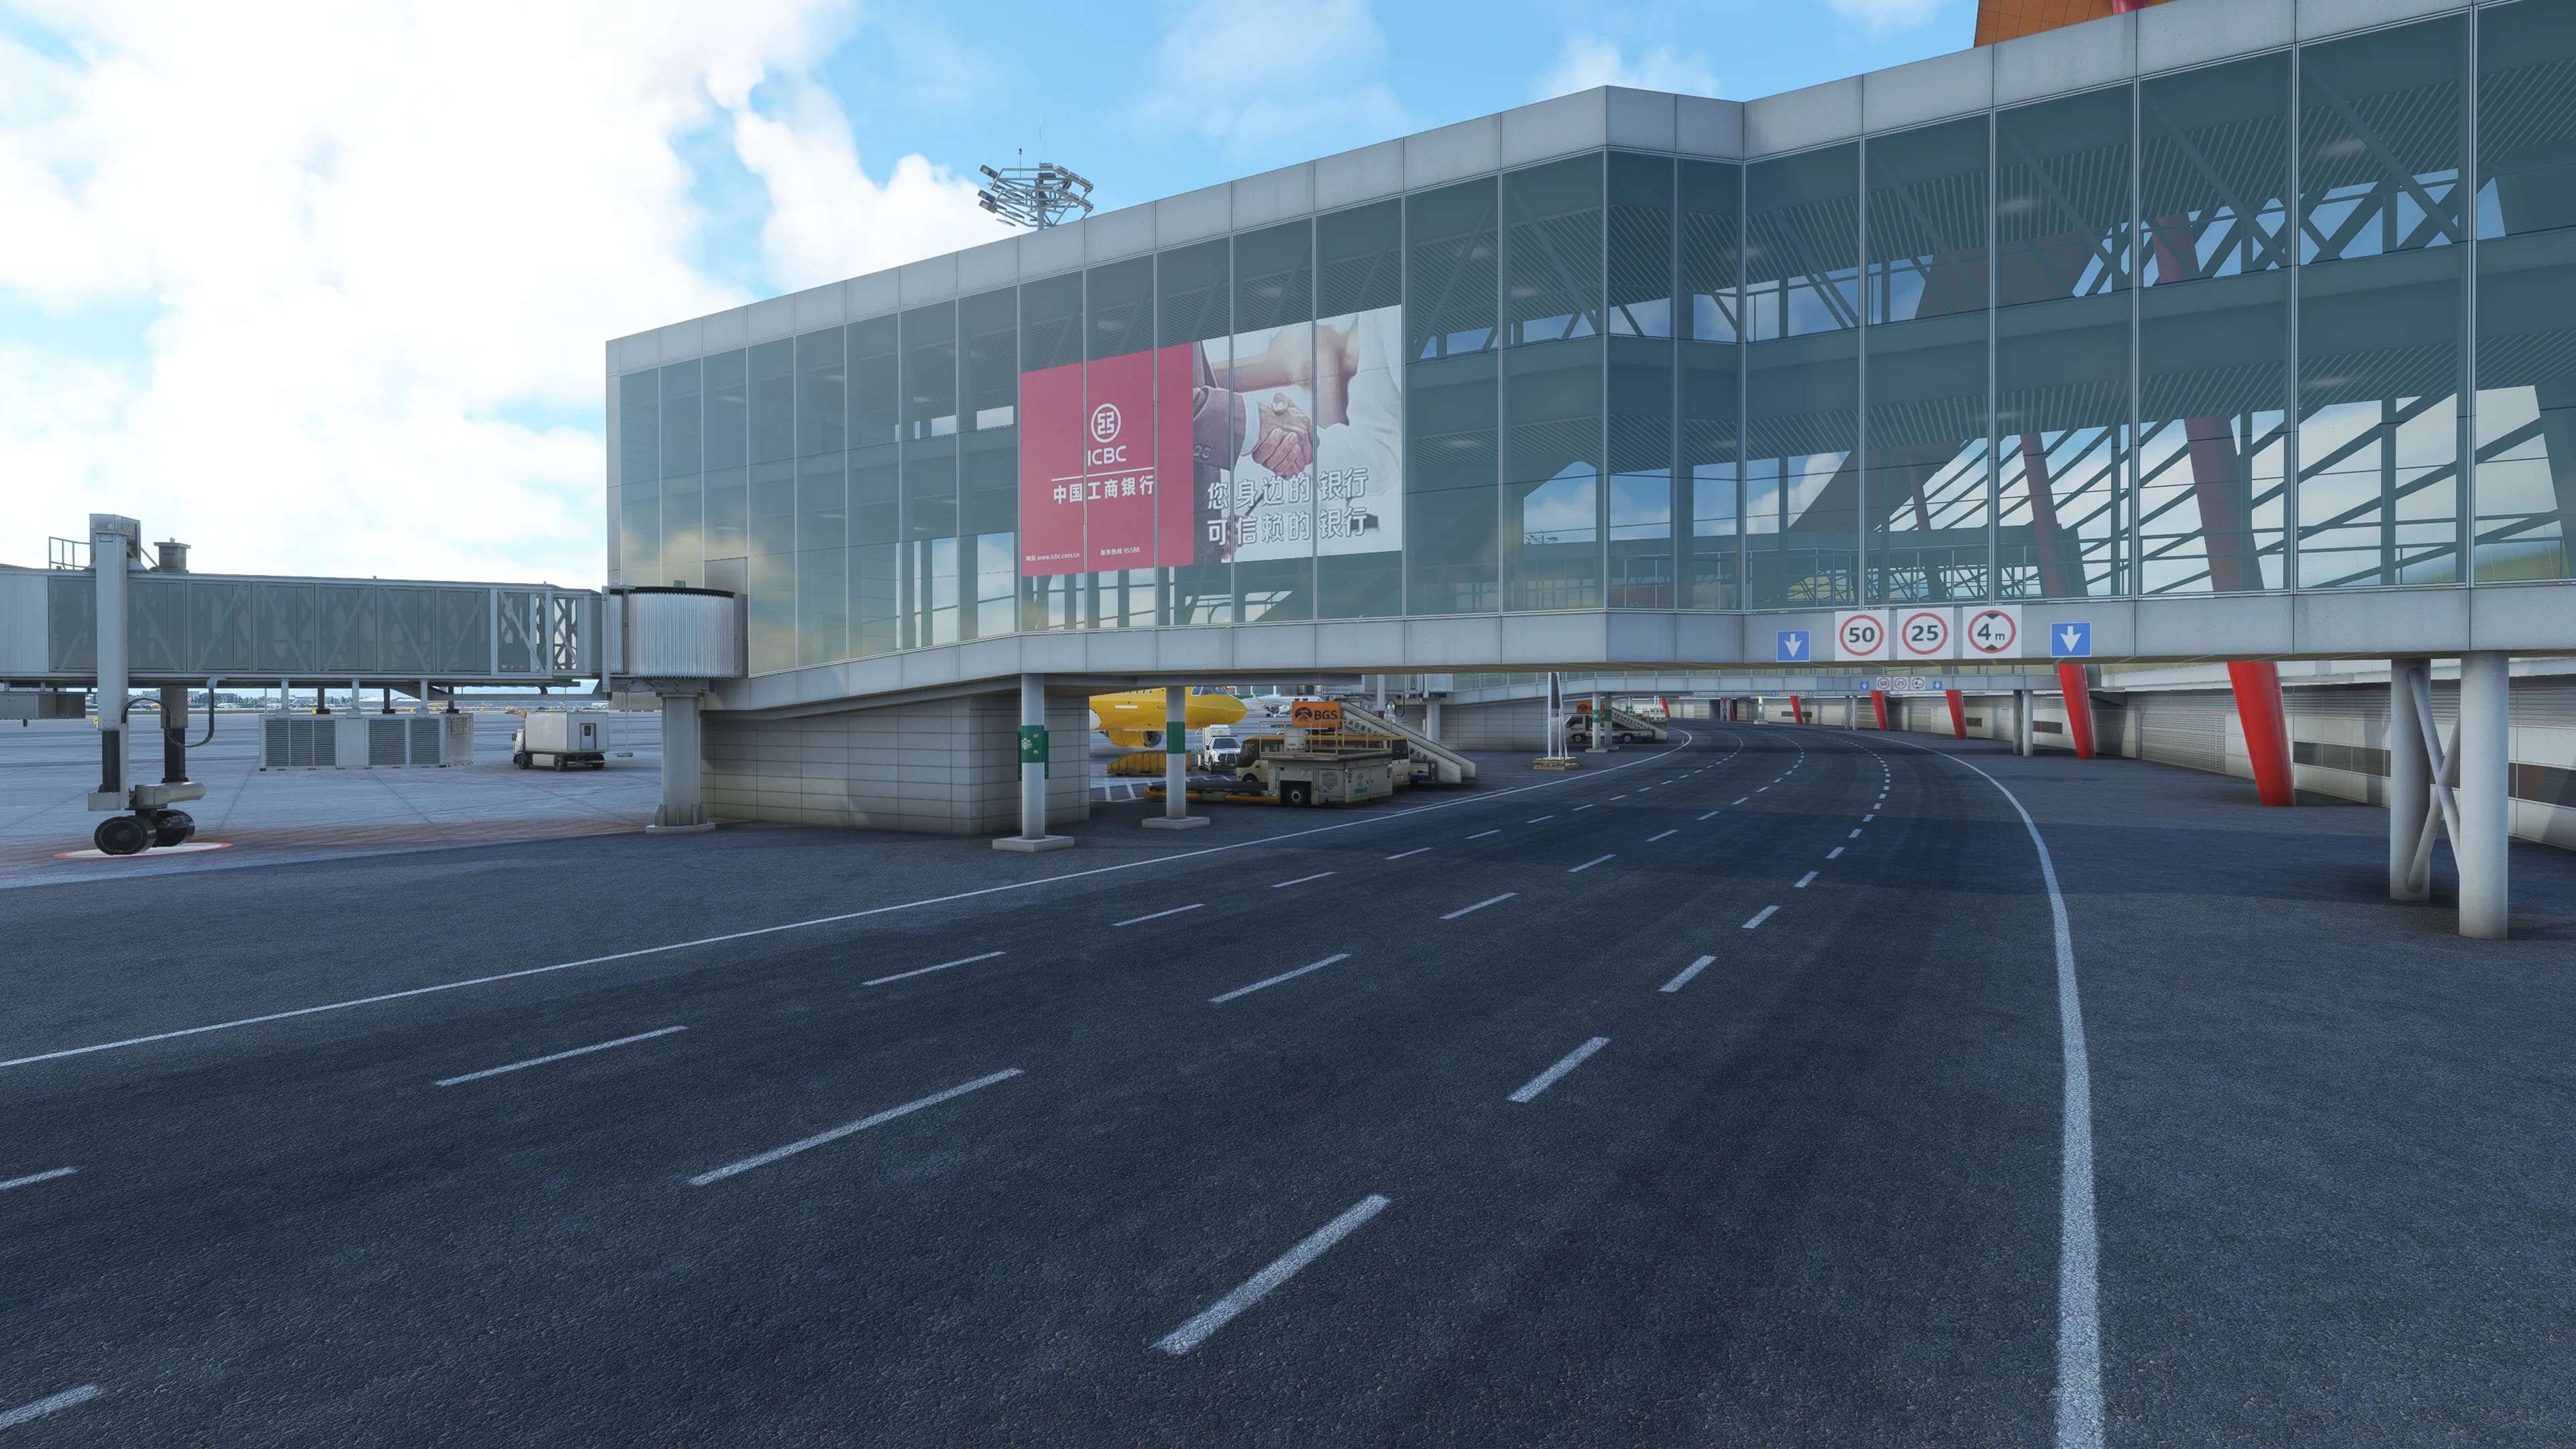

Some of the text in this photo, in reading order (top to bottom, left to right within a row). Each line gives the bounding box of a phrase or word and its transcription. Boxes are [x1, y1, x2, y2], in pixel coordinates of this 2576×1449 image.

[1087, 445, 1126, 466] ICBC
[1054, 475, 1154, 504] 中国工商银行
[1207, 468, 1368, 510] 您身边的银行
[1207, 506, 1368, 546] 可信赖的银行
[1037, 553, 1080, 561] www.icbc.com.cn
[1848, 627, 1875, 643] 50
[1911, 625, 1939, 642] 25
[1314, 710, 1338, 720] BGS
